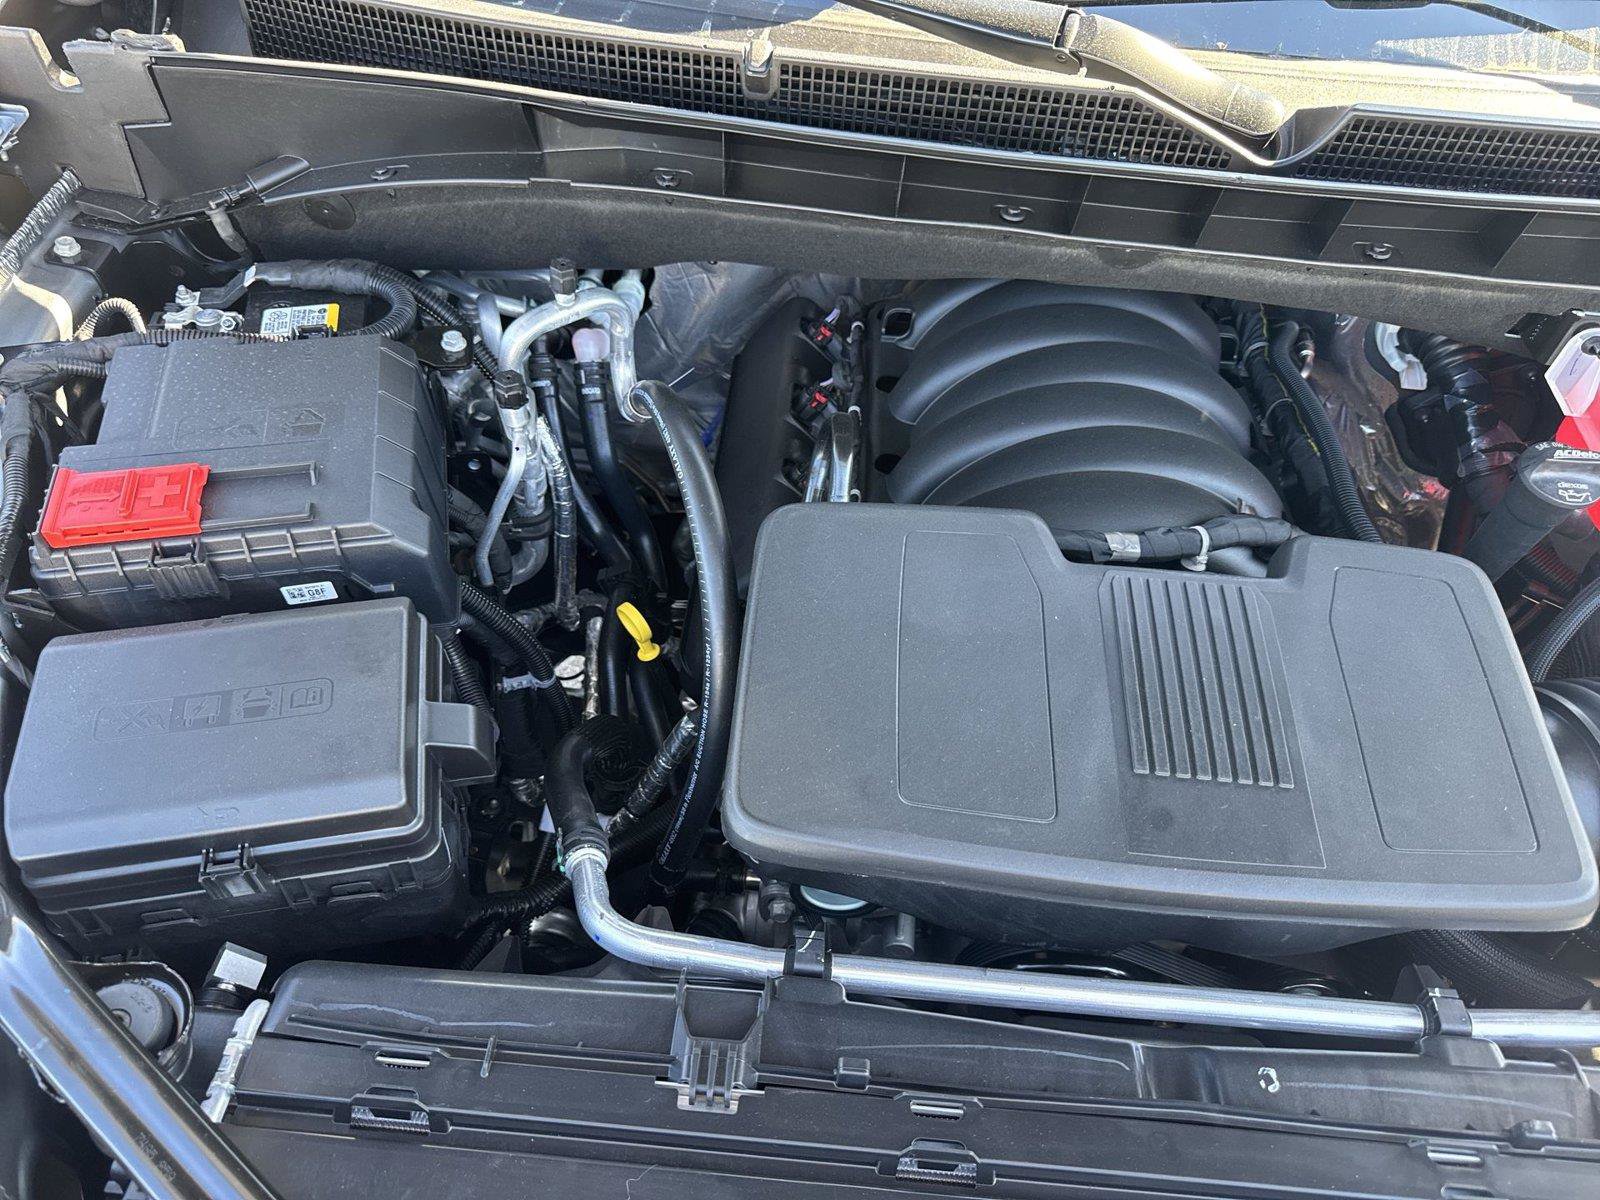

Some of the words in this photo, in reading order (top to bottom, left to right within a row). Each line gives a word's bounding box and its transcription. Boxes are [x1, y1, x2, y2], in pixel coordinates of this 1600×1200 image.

[1535, 442, 1550, 450] SAE
[668, 444, 683, 479] GALAXY
[701, 707, 709, 728] HOSE
[698, 729, 706, 759] SUCTION
